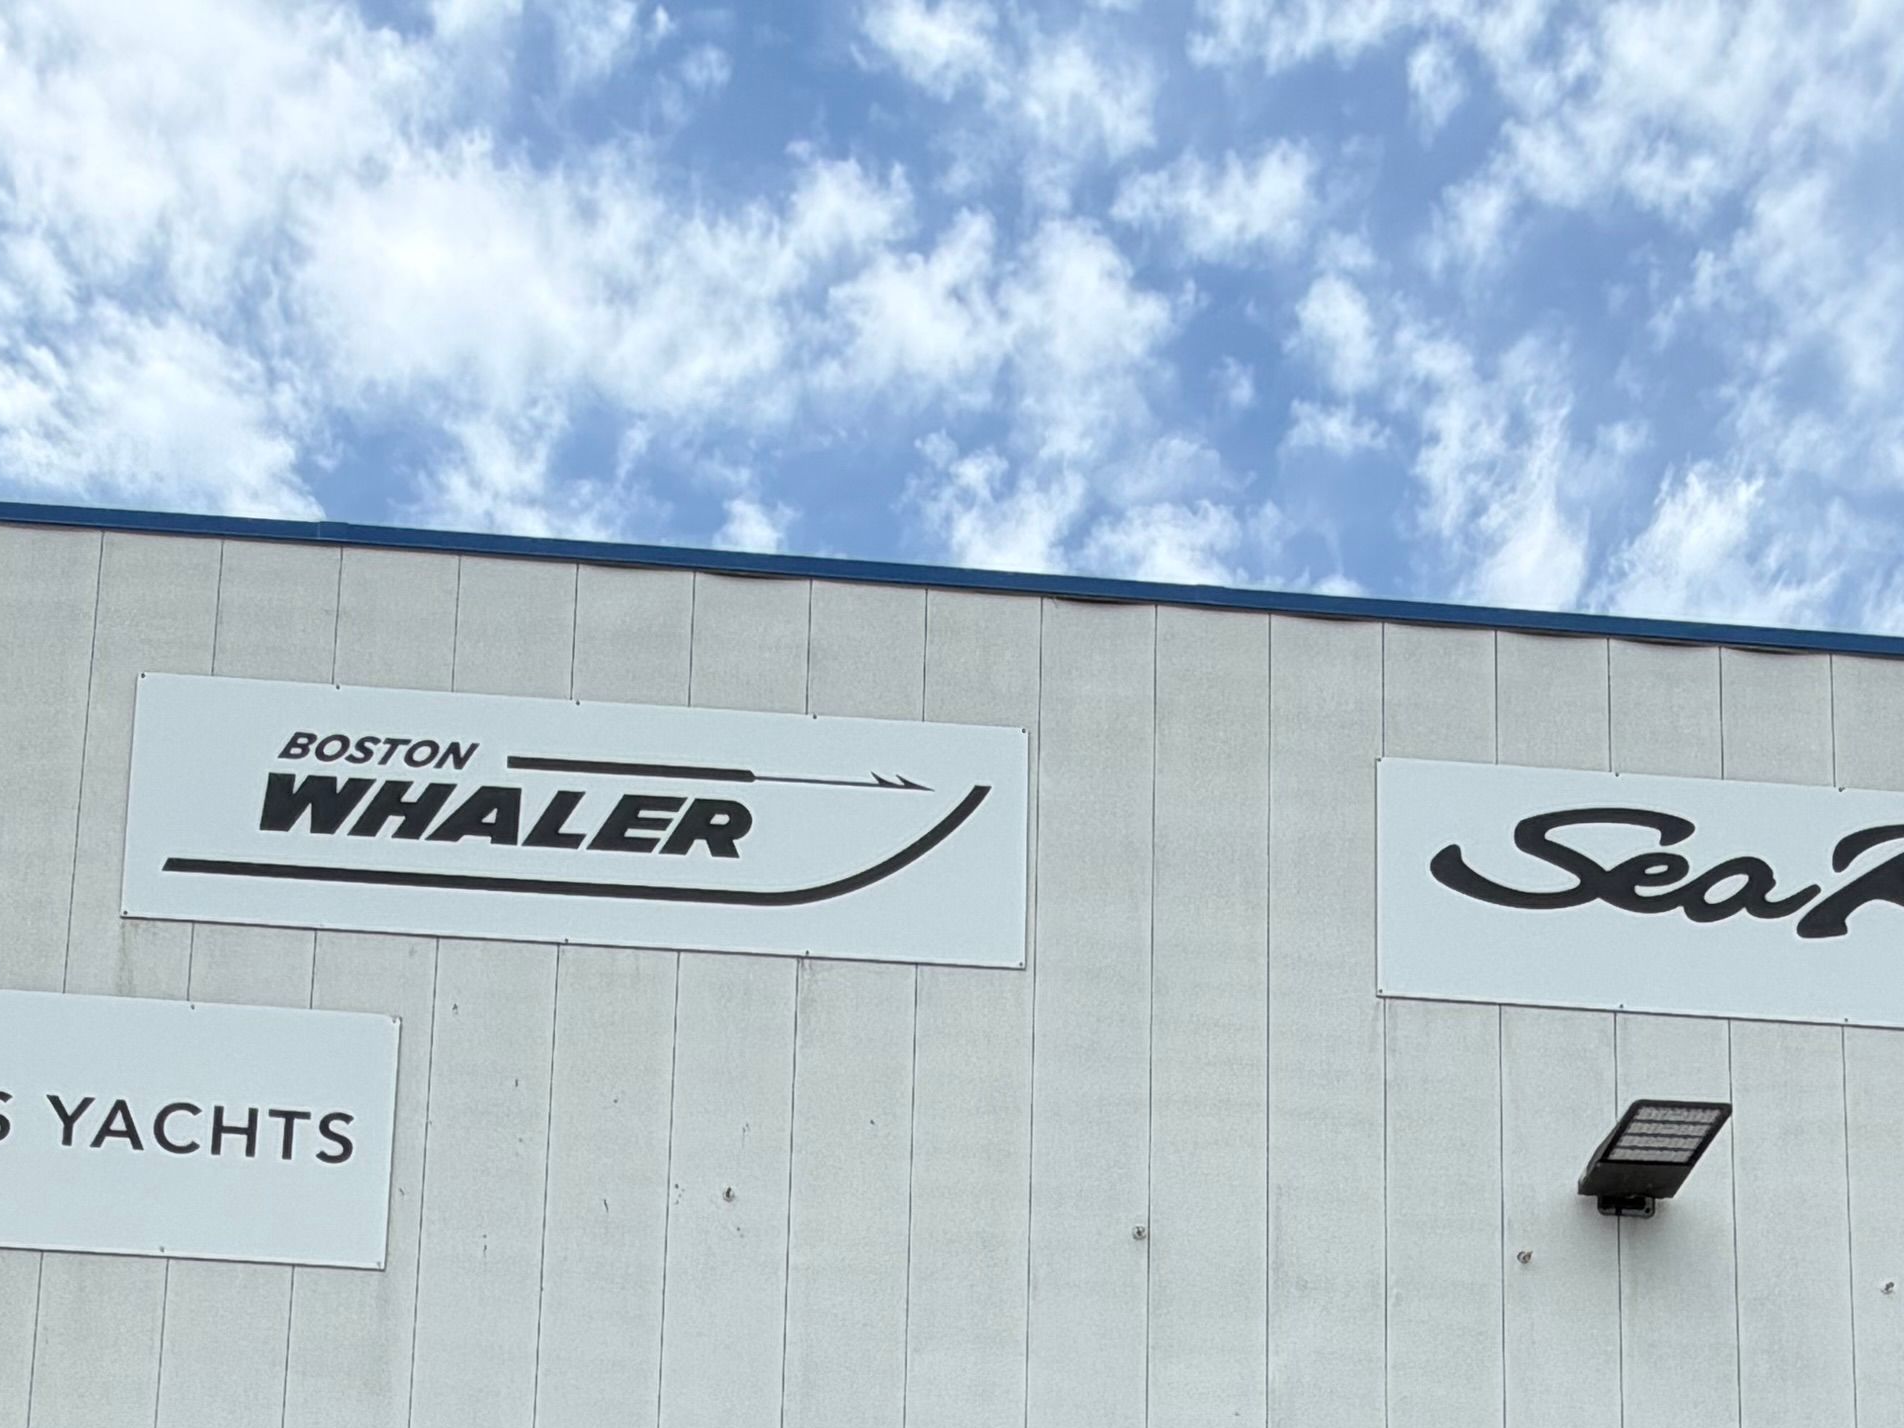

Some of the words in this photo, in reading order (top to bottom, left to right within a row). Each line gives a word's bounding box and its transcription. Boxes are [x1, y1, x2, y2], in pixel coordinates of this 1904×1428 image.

[277, 731, 480, 770] BOSTON
[259, 771, 753, 859] WHALER
[1429, 807, 1822, 923] Sea
[46, 1094, 355, 1164] YACHTS
